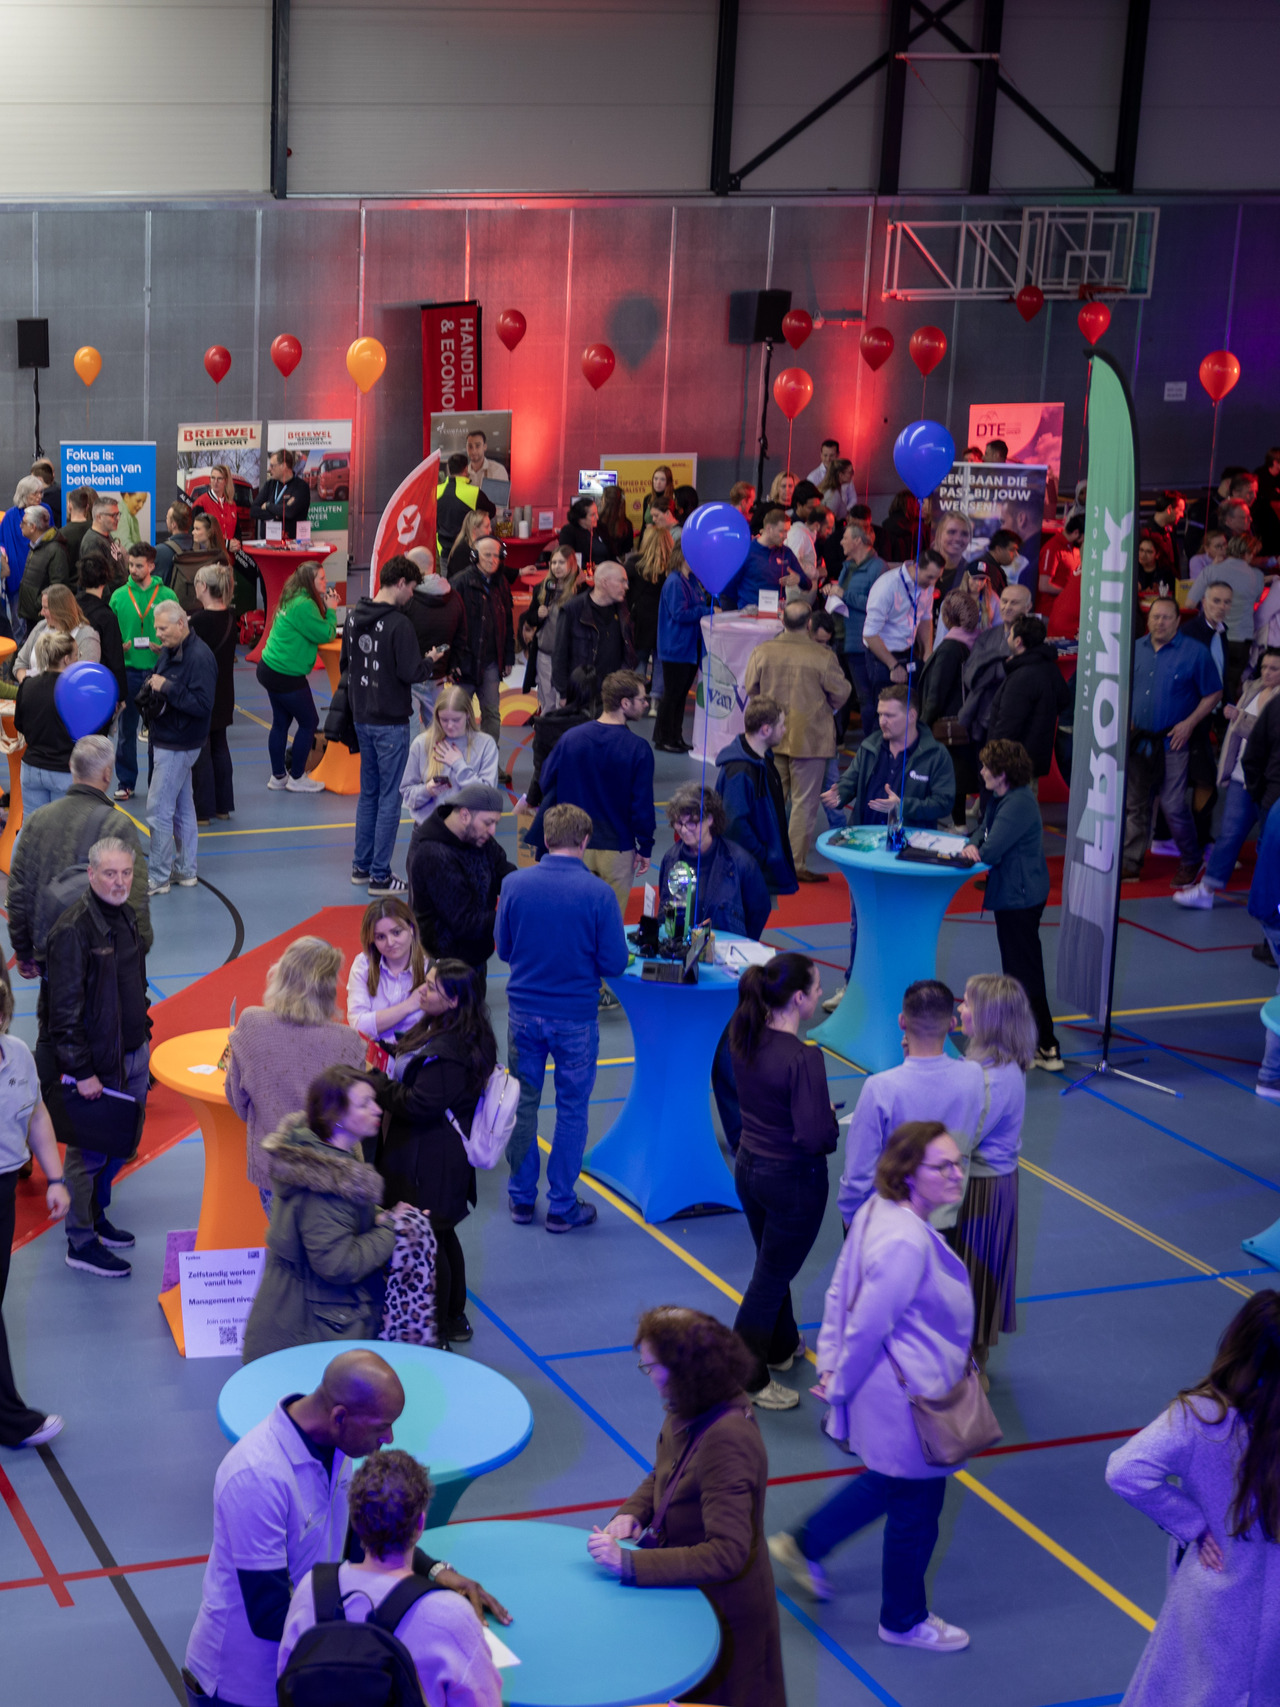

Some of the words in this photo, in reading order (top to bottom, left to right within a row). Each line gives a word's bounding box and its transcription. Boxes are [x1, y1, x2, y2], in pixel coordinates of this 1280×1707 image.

[441, 319, 454, 334] &
[460, 318, 474, 398] HANDEL
[441, 338, 456, 412] ECONO
[184, 428, 256, 442] BREEWEL
[288, 430, 332, 440] BREEWEL
[976, 423, 1006, 437] DTE
[195, 438, 248, 448] TRANSPORT
[66, 448, 100, 461] Fokus
[66, 464, 88, 473] een
[90, 462, 118, 473] baan
[121, 464, 142, 474] van
[66, 474, 124, 486] betekenis!
[969, 474, 1004, 486] BAAN
[1006, 476, 1028, 488] DIE
[974, 488, 990, 500] BIJ
[993, 490, 1032, 502] JOUW
[188, 1269, 229, 1280] Zelfstandig
[230, 1268, 256, 1276] werken
[188, 1297, 235, 1306] Management
[206, 1318, 219, 1326] Join
